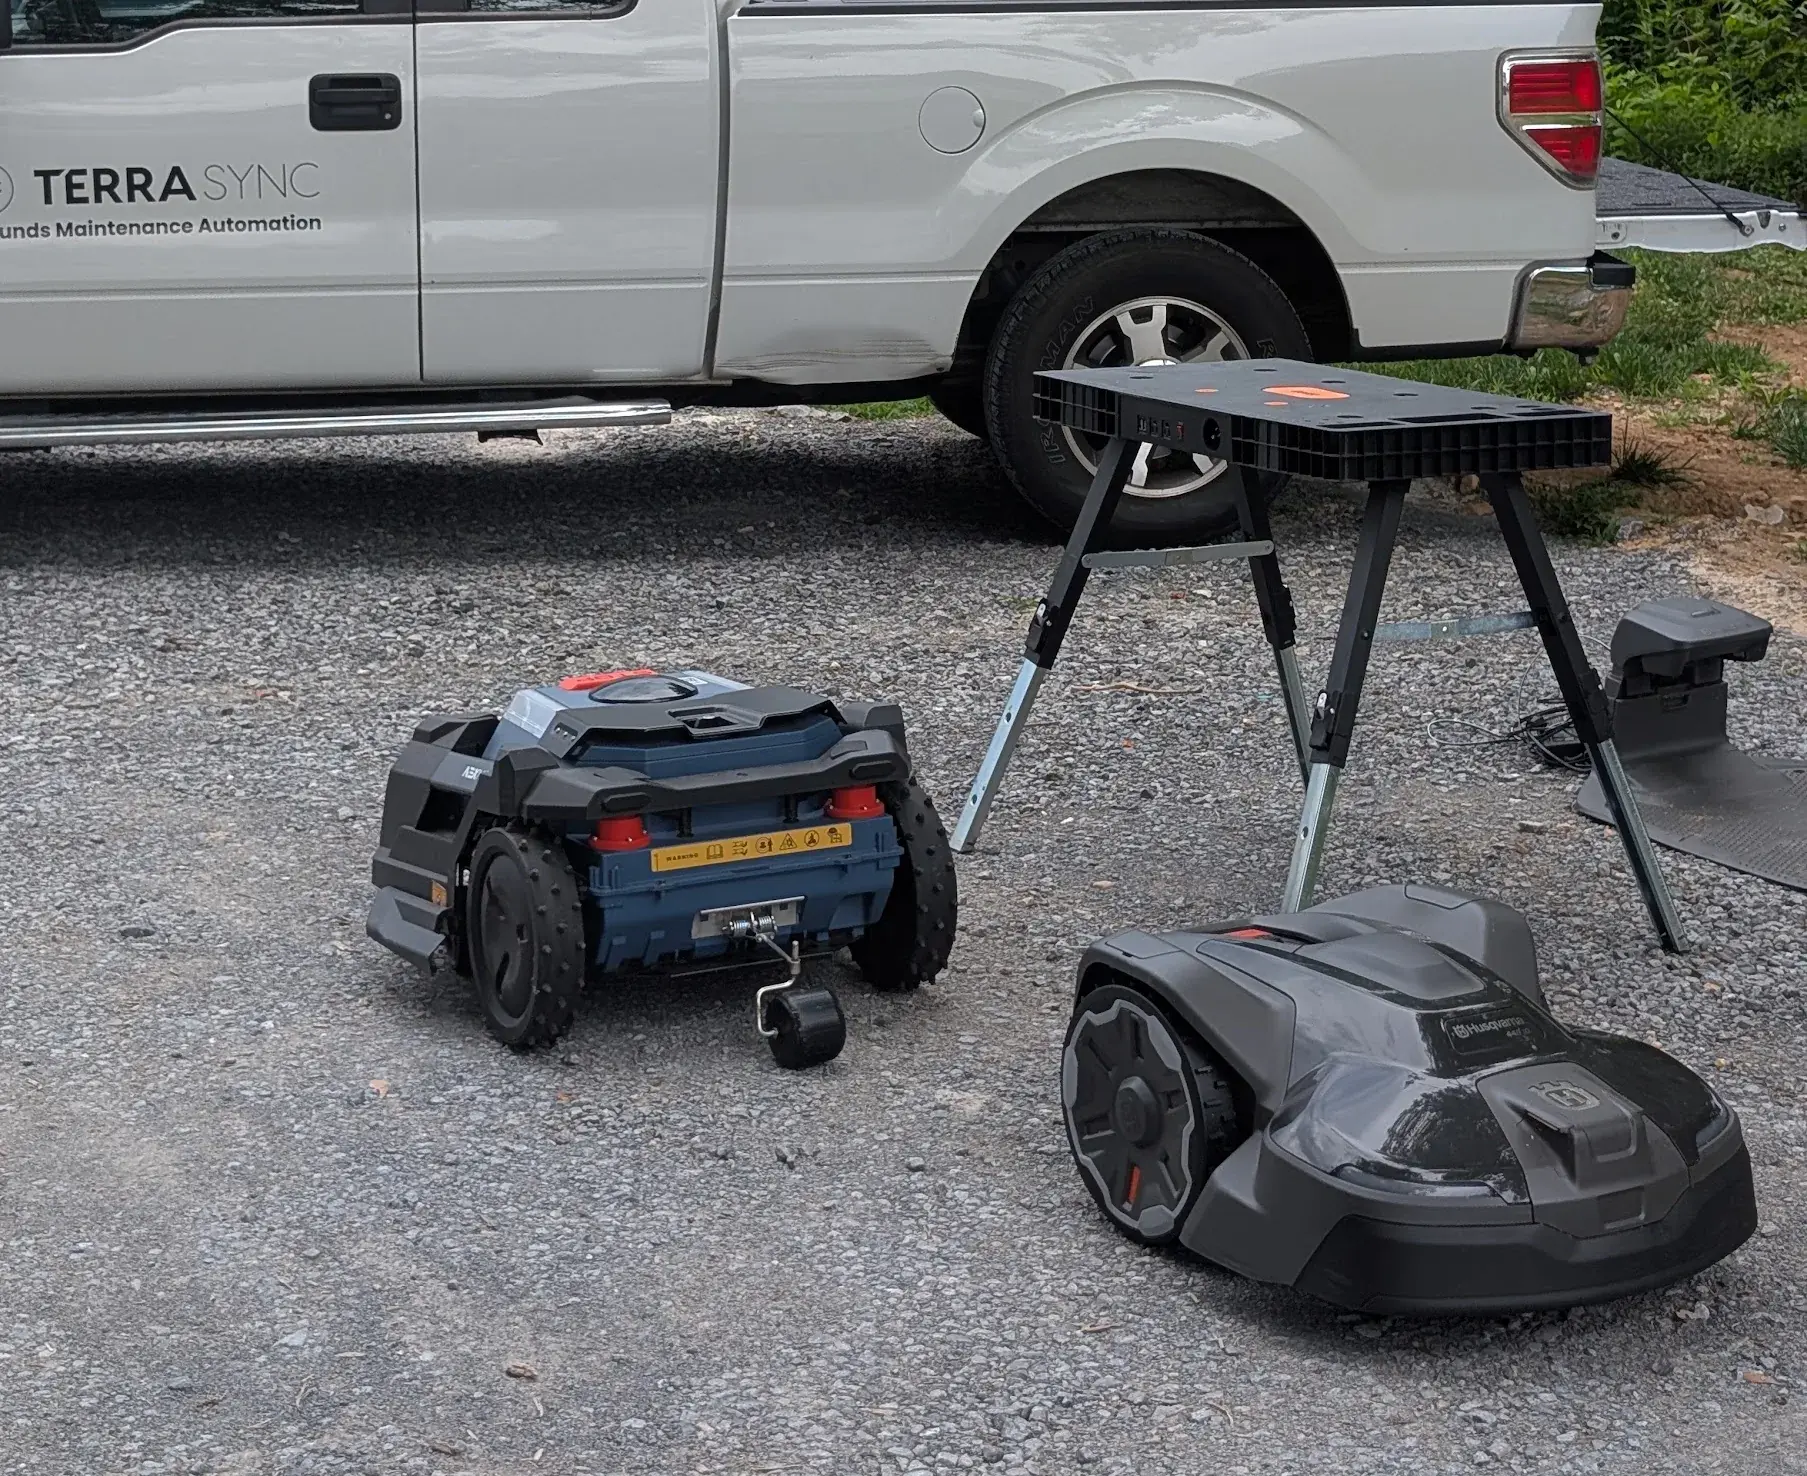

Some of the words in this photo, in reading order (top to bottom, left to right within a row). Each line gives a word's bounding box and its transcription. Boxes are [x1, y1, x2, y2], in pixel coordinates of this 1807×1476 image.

[56, 219, 193, 237] Maintenance
[199, 214, 322, 233] Automation
[1038, 296, 1095, 464] IRMAN
[1466, 1016, 1525, 1035] Husqvarna
